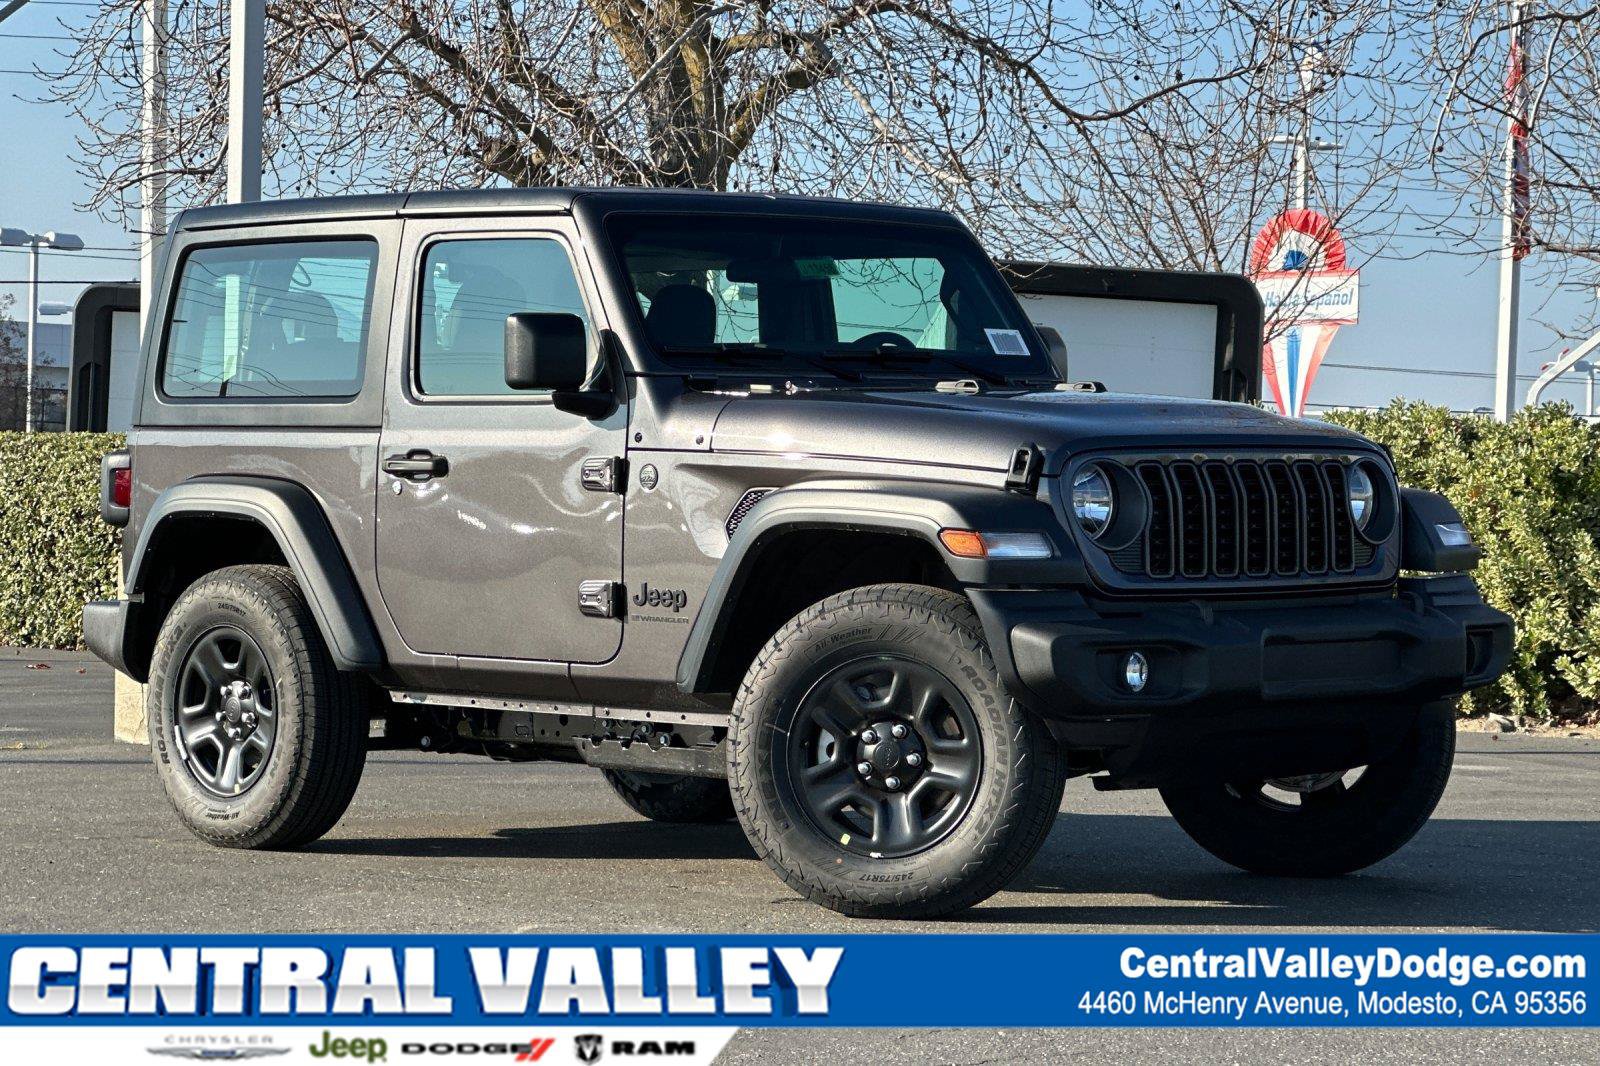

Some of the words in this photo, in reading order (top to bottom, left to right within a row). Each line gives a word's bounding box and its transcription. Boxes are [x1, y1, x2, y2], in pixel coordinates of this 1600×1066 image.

[1265, 291, 1301, 307] Haba
[1303, 287, 1354, 310] spañol
[633, 581, 687, 612] Jeep
[640, 614, 689, 624] WRANGLER
[815, 627, 873, 652] All-Weather
[960, 664, 1007, 765] ROADIAN
[859, 871, 914, 883] 245/75R17
